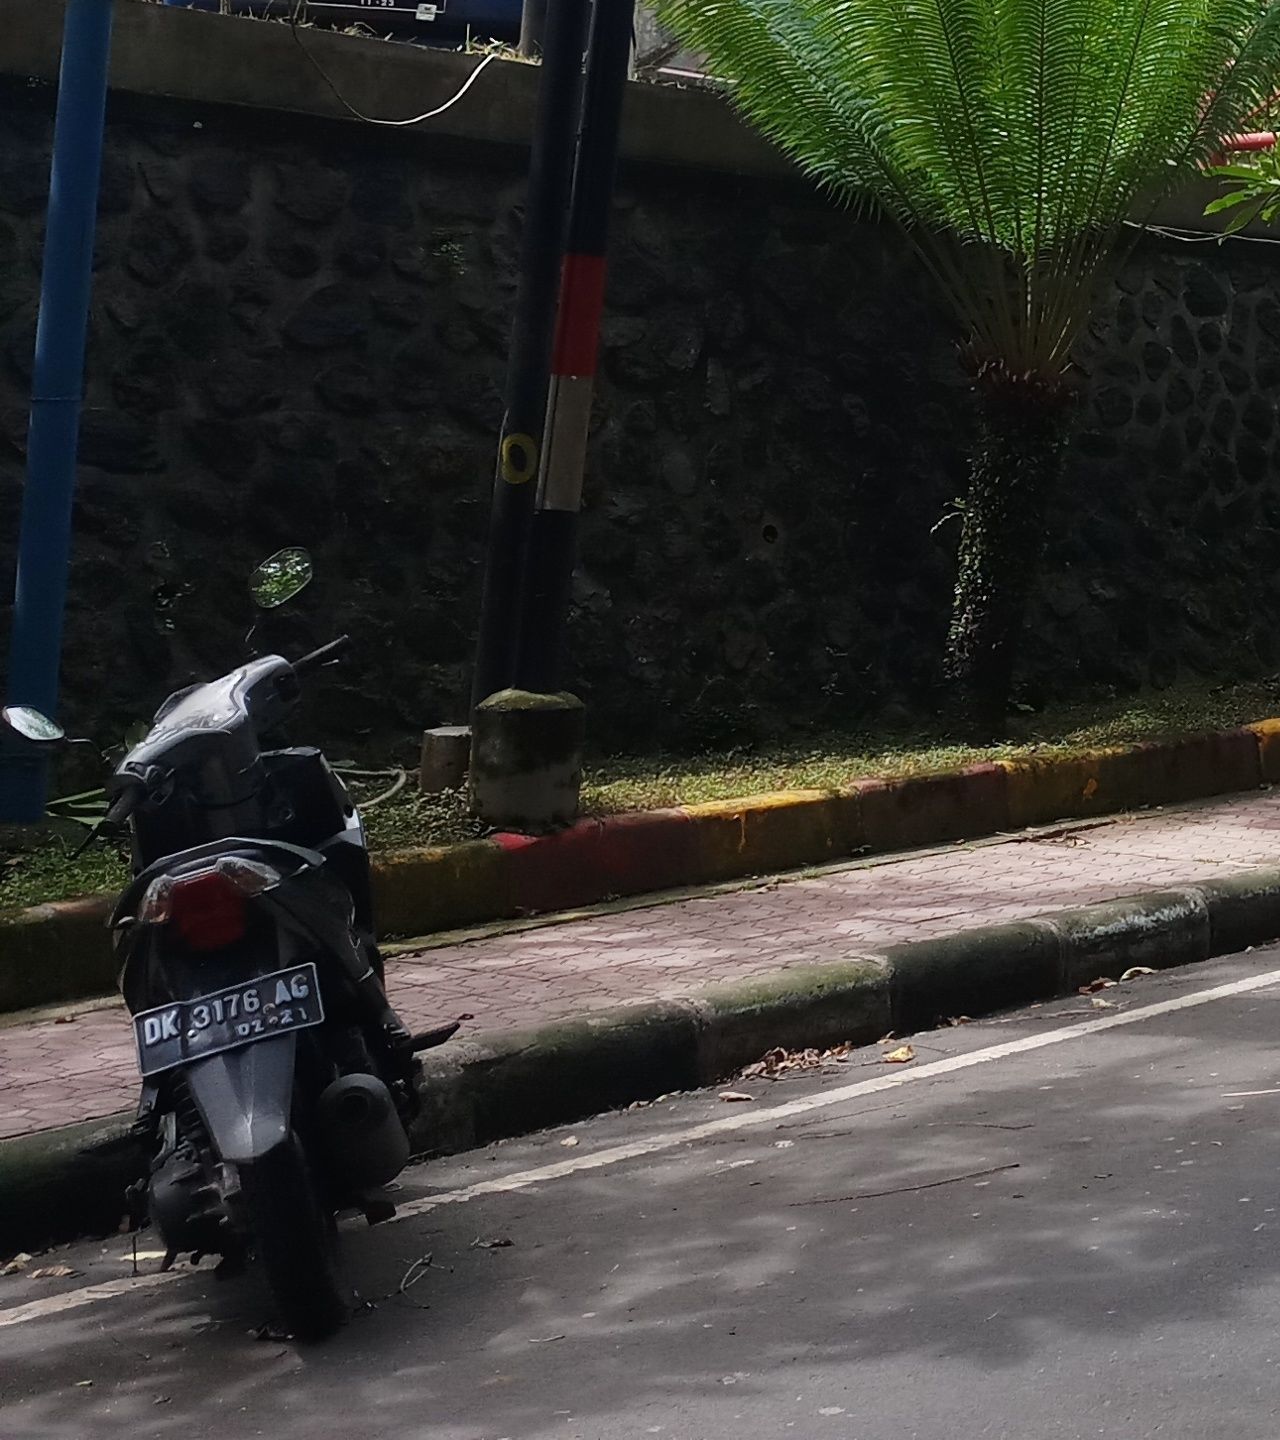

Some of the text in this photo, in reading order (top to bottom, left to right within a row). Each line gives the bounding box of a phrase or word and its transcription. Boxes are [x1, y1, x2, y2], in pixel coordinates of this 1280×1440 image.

[144, 974, 310, 1046] DK 3176 AG
